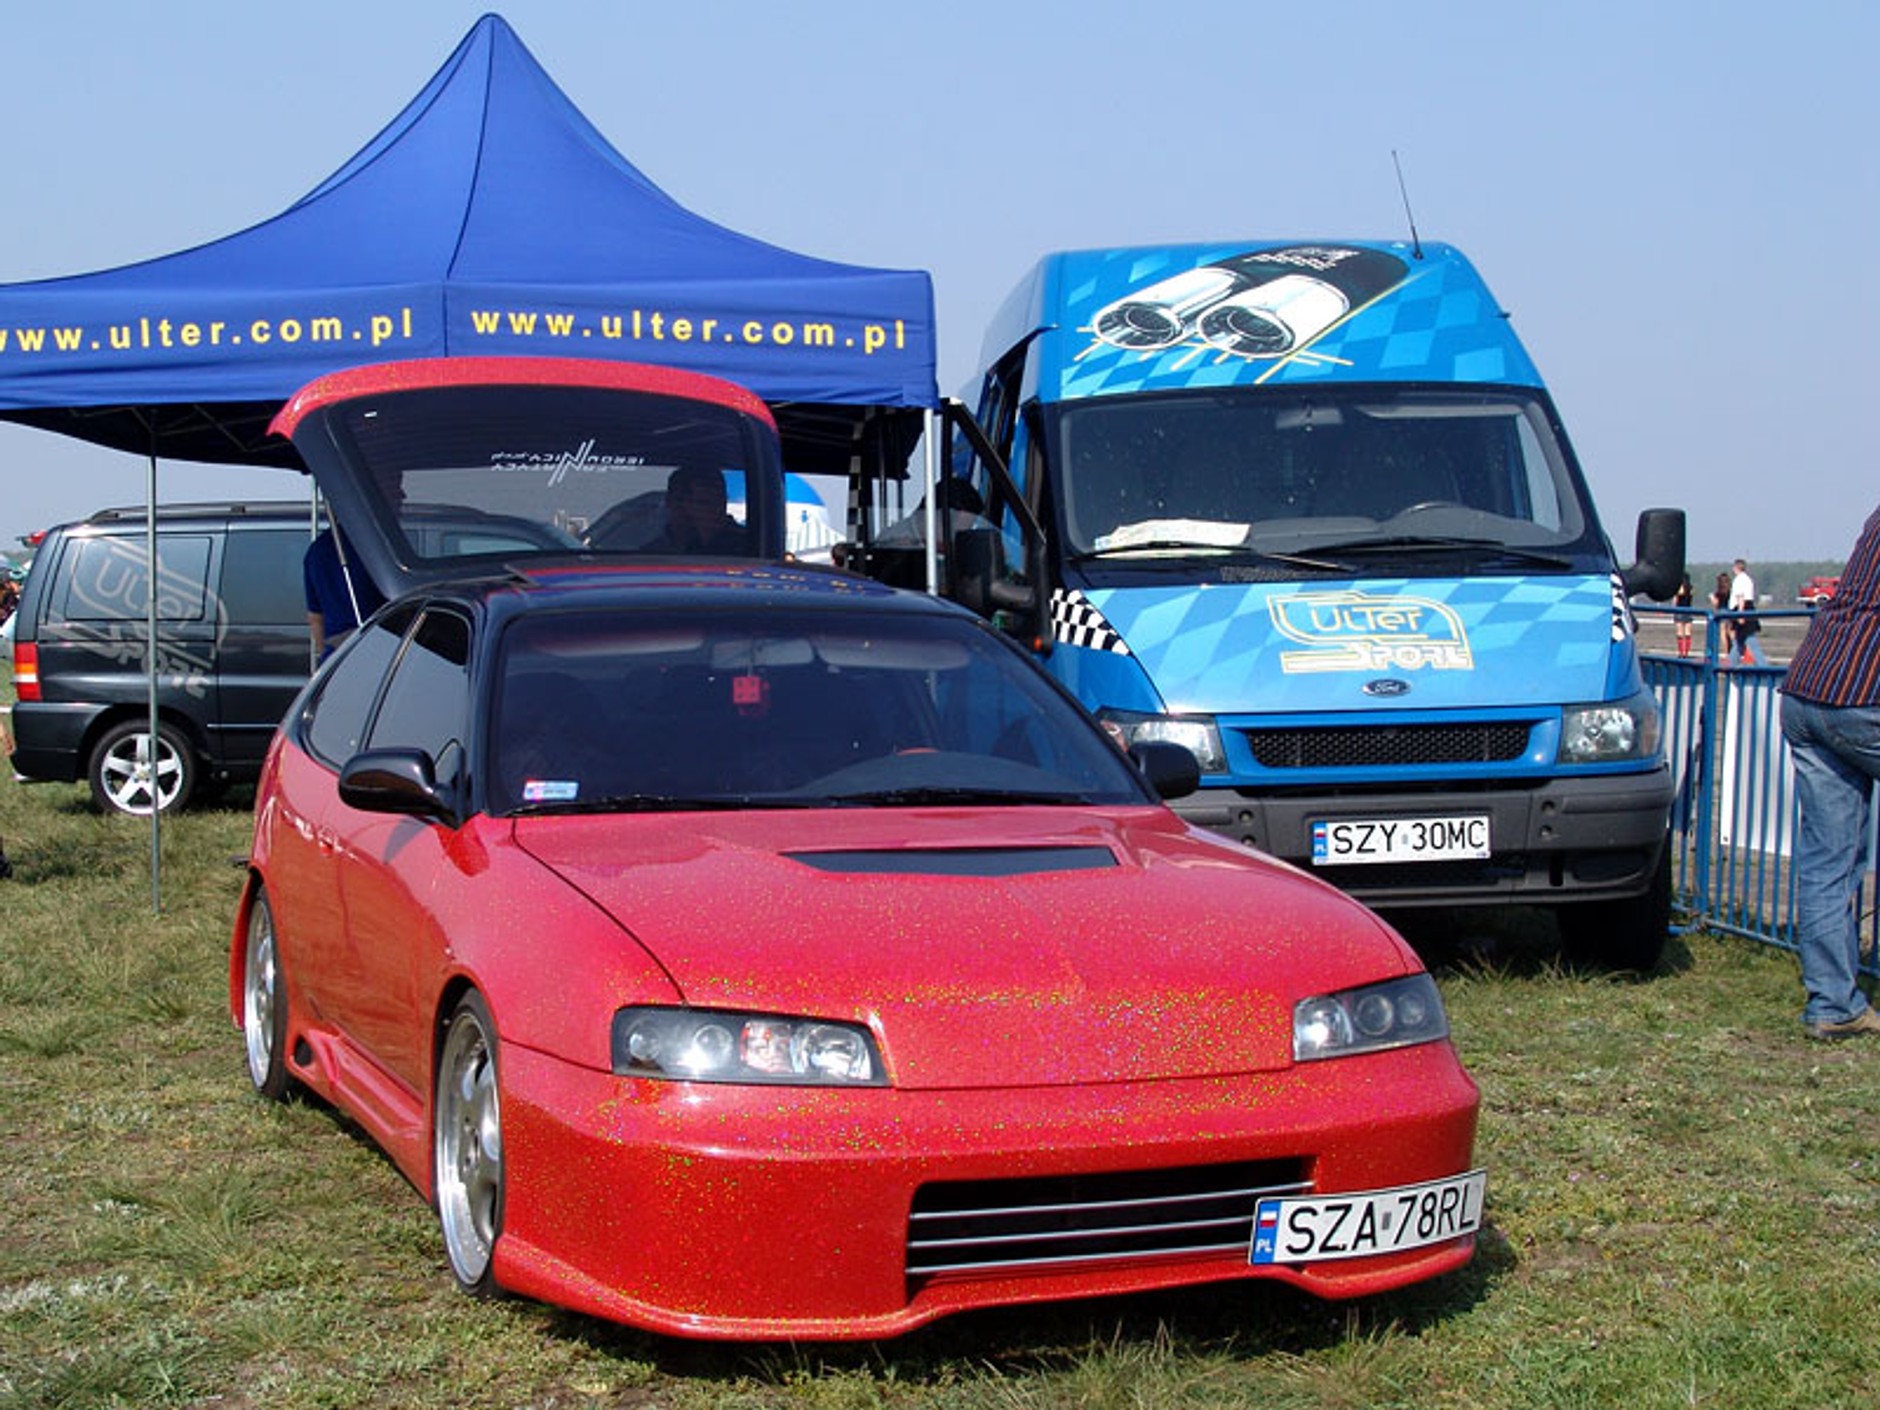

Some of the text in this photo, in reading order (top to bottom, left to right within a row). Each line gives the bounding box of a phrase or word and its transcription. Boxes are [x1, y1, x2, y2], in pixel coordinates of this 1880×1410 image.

[0, 307, 412, 351] ww.ulter.com.pl
[470, 309, 905, 353] www.ulter.com.pl
[1332, 820, 1486, 854] SZY 30MC
[1285, 1182, 1475, 1254] SZA 78RL
